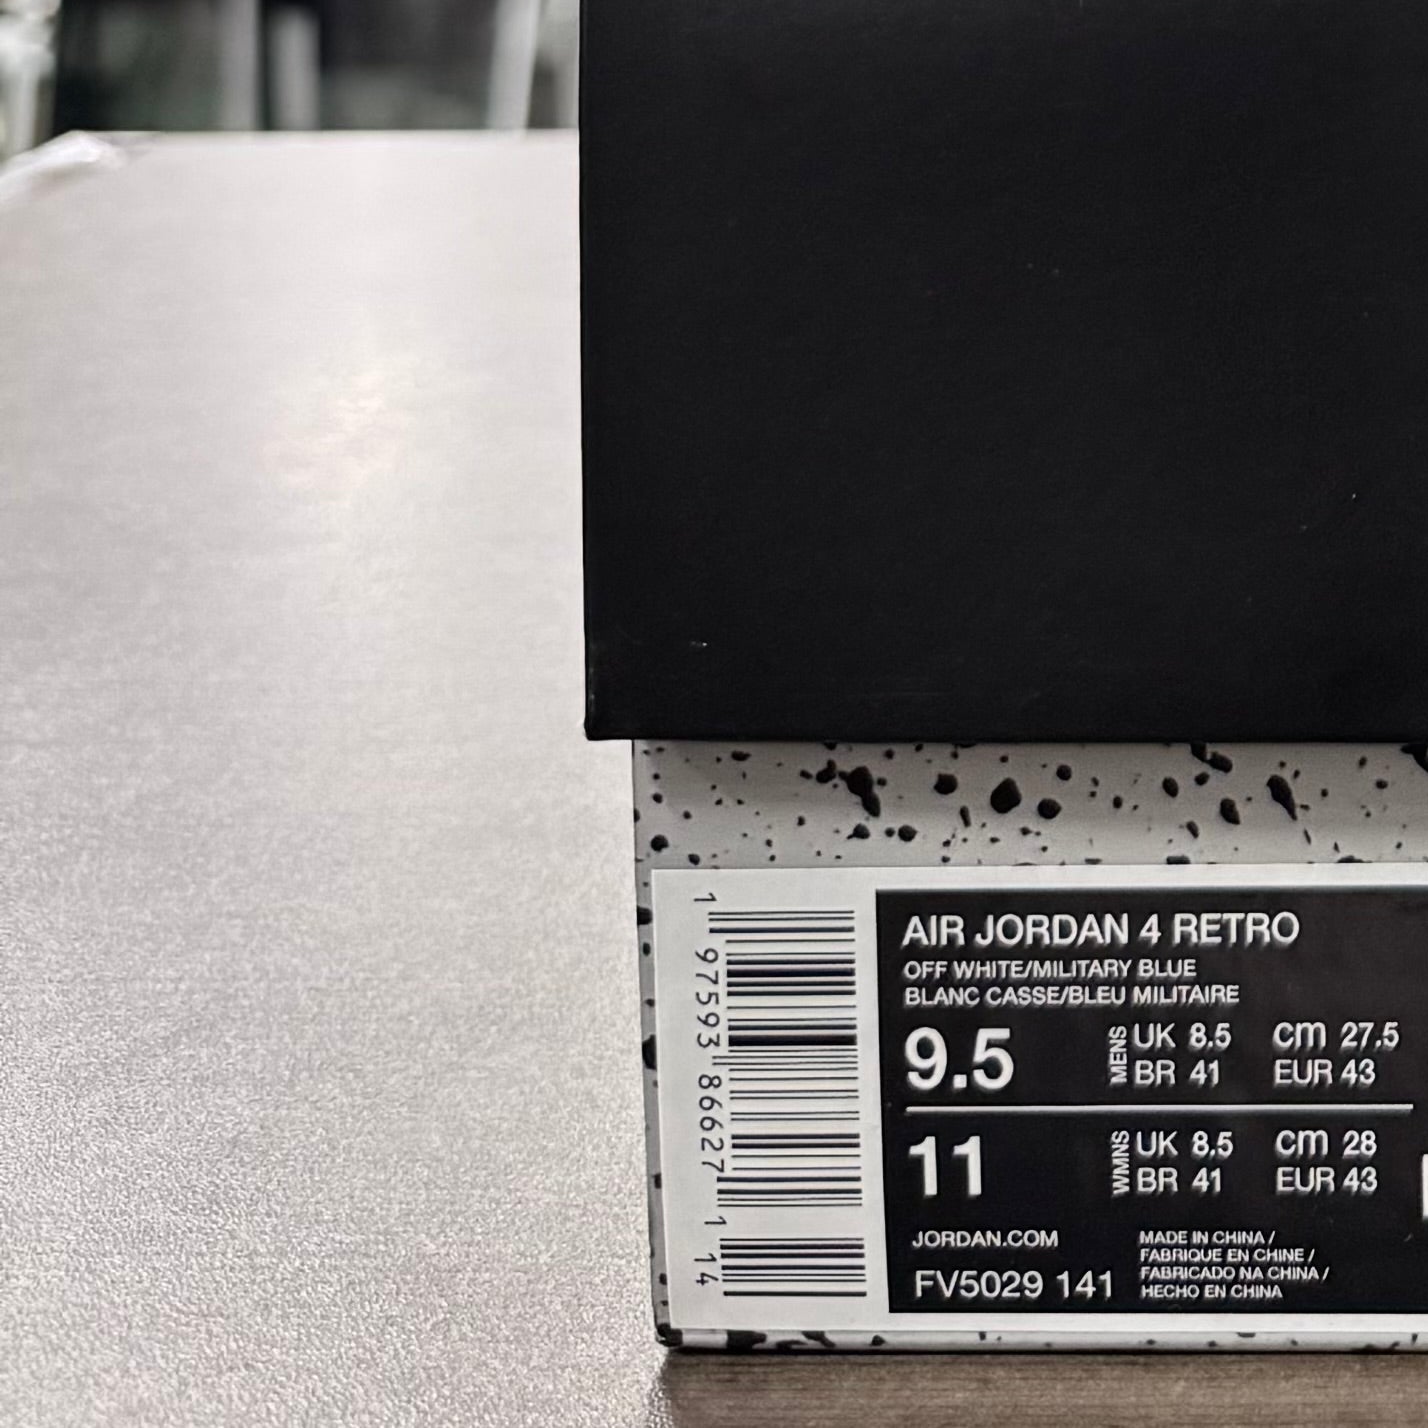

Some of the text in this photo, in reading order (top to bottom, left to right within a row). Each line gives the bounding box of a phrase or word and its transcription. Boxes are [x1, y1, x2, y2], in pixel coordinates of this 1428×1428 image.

[901, 912, 1300, 946] AIR JORDAN 4 RETRO
[904, 958, 1197, 980] OFF WHITE/MILITARY BLUE
[696, 948, 721, 1048] 97593
[905, 984, 1240, 1006] BLANC CASSE/BLEU MILITAIRE
[1133, 1022, 1232, 1049] UK 8.5
[1272, 1021, 1400, 1050] cm 27.5
[904, 1026, 1014, 1091] 9.5
[1108, 1025, 1127, 1086] MENS
[1134, 1059, 1220, 1086] BR 41
[1274, 1058, 1377, 1086] EUR 43
[698, 1074, 725, 1174] 86627
[1136, 1130, 1234, 1157] UK 8.5
[1274, 1129, 1377, 1157] cm 28
[909, 1135, 982, 1197] 11
[1111, 1130, 1130, 1197] WMNS
[1137, 1167, 1222, 1194] BR 41
[1276, 1166, 1378, 1194] EUR 43
[912, 1230, 1059, 1248] JORDAN.COM
[1139, 1231, 1188, 1245] MADE
[1192, 1231, 1209, 1244] IN
[1212, 1231, 1263, 1245] CHINA
[1140, 1248, 1223, 1263] FABRIQUE
[1226, 1249, 1250, 1262] EN
[1253, 1248, 1305, 1262] CHINE
[694, 1254, 719, 1286] 14
[1139, 1266, 1236, 1281] FABRICADO
[1240, 1266, 1265, 1280] NA
[1267, 1266, 1319, 1280] CHINA
[914, 1269, 1114, 1300] FV5029 141
[1141, 1284, 1283, 1299] HECHO EN CHINA
